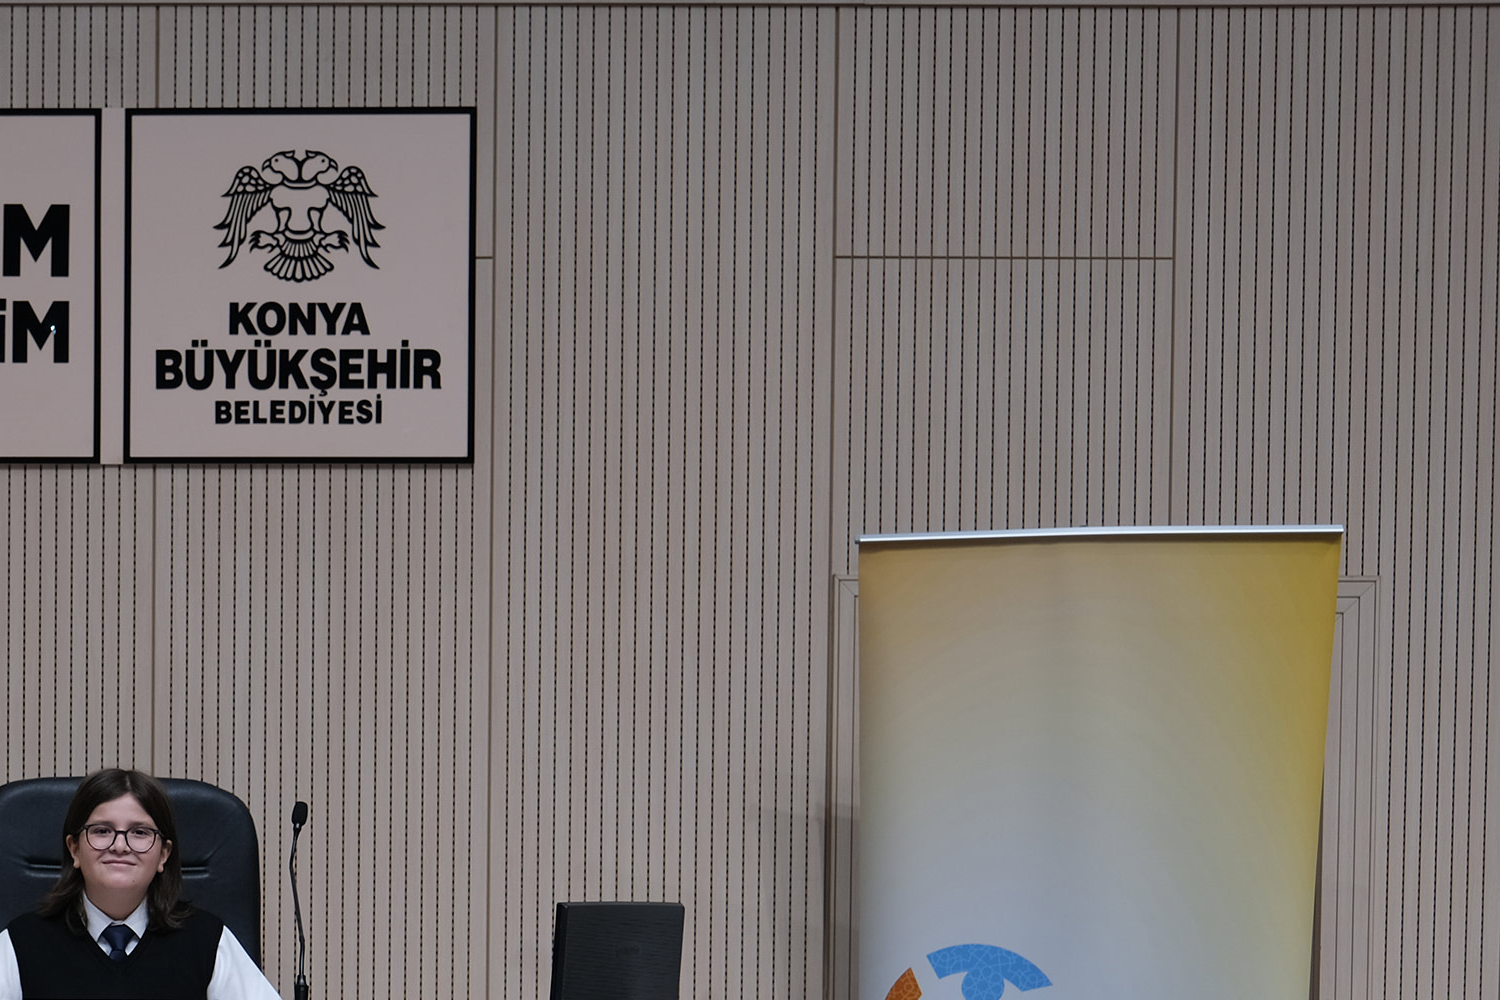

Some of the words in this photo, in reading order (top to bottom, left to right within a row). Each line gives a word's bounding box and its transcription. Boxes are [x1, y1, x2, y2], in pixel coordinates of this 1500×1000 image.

[229, 301, 371, 336] KONYA
[155, 339, 442, 396] BÜYÜKŞEHİR
[214, 394, 383, 425] BELEDİYESİ
